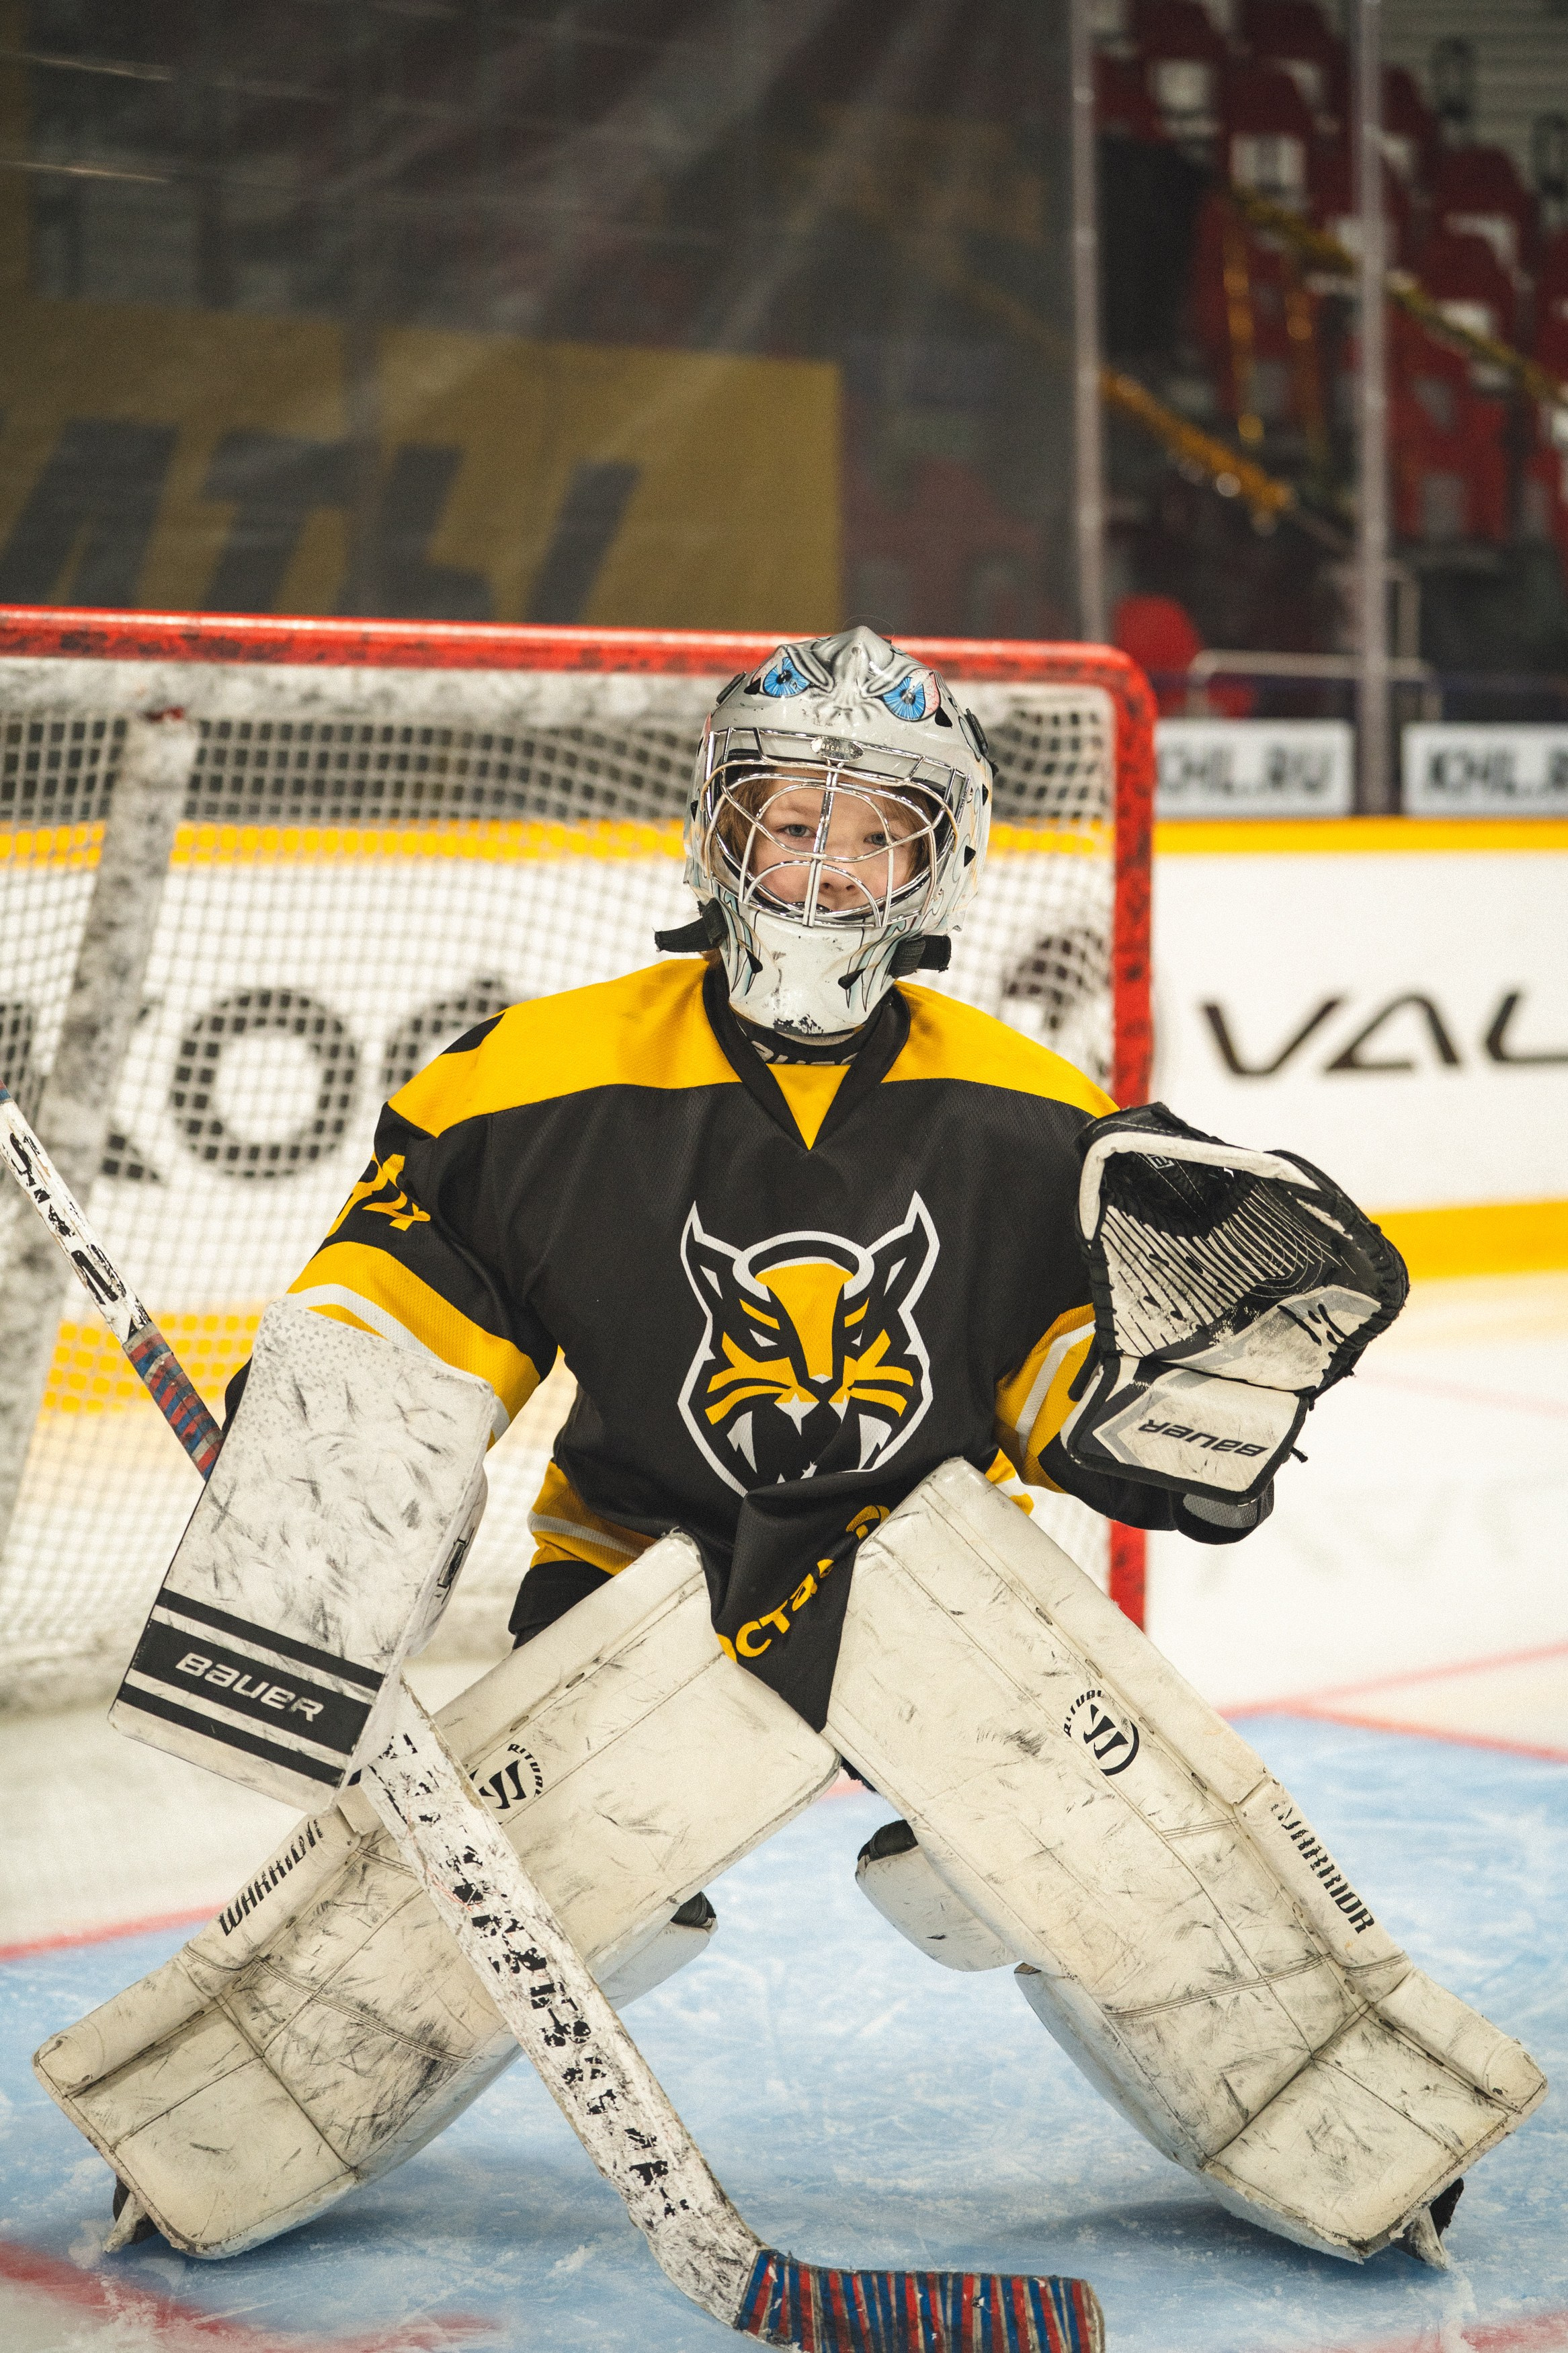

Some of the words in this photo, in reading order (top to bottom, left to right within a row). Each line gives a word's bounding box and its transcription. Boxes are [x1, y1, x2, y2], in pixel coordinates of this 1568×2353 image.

[1138, 1419, 1270, 1458] BAUER
[175, 1651, 325, 1722] BAUER
[507, 1743, 543, 1798] RITUAL
